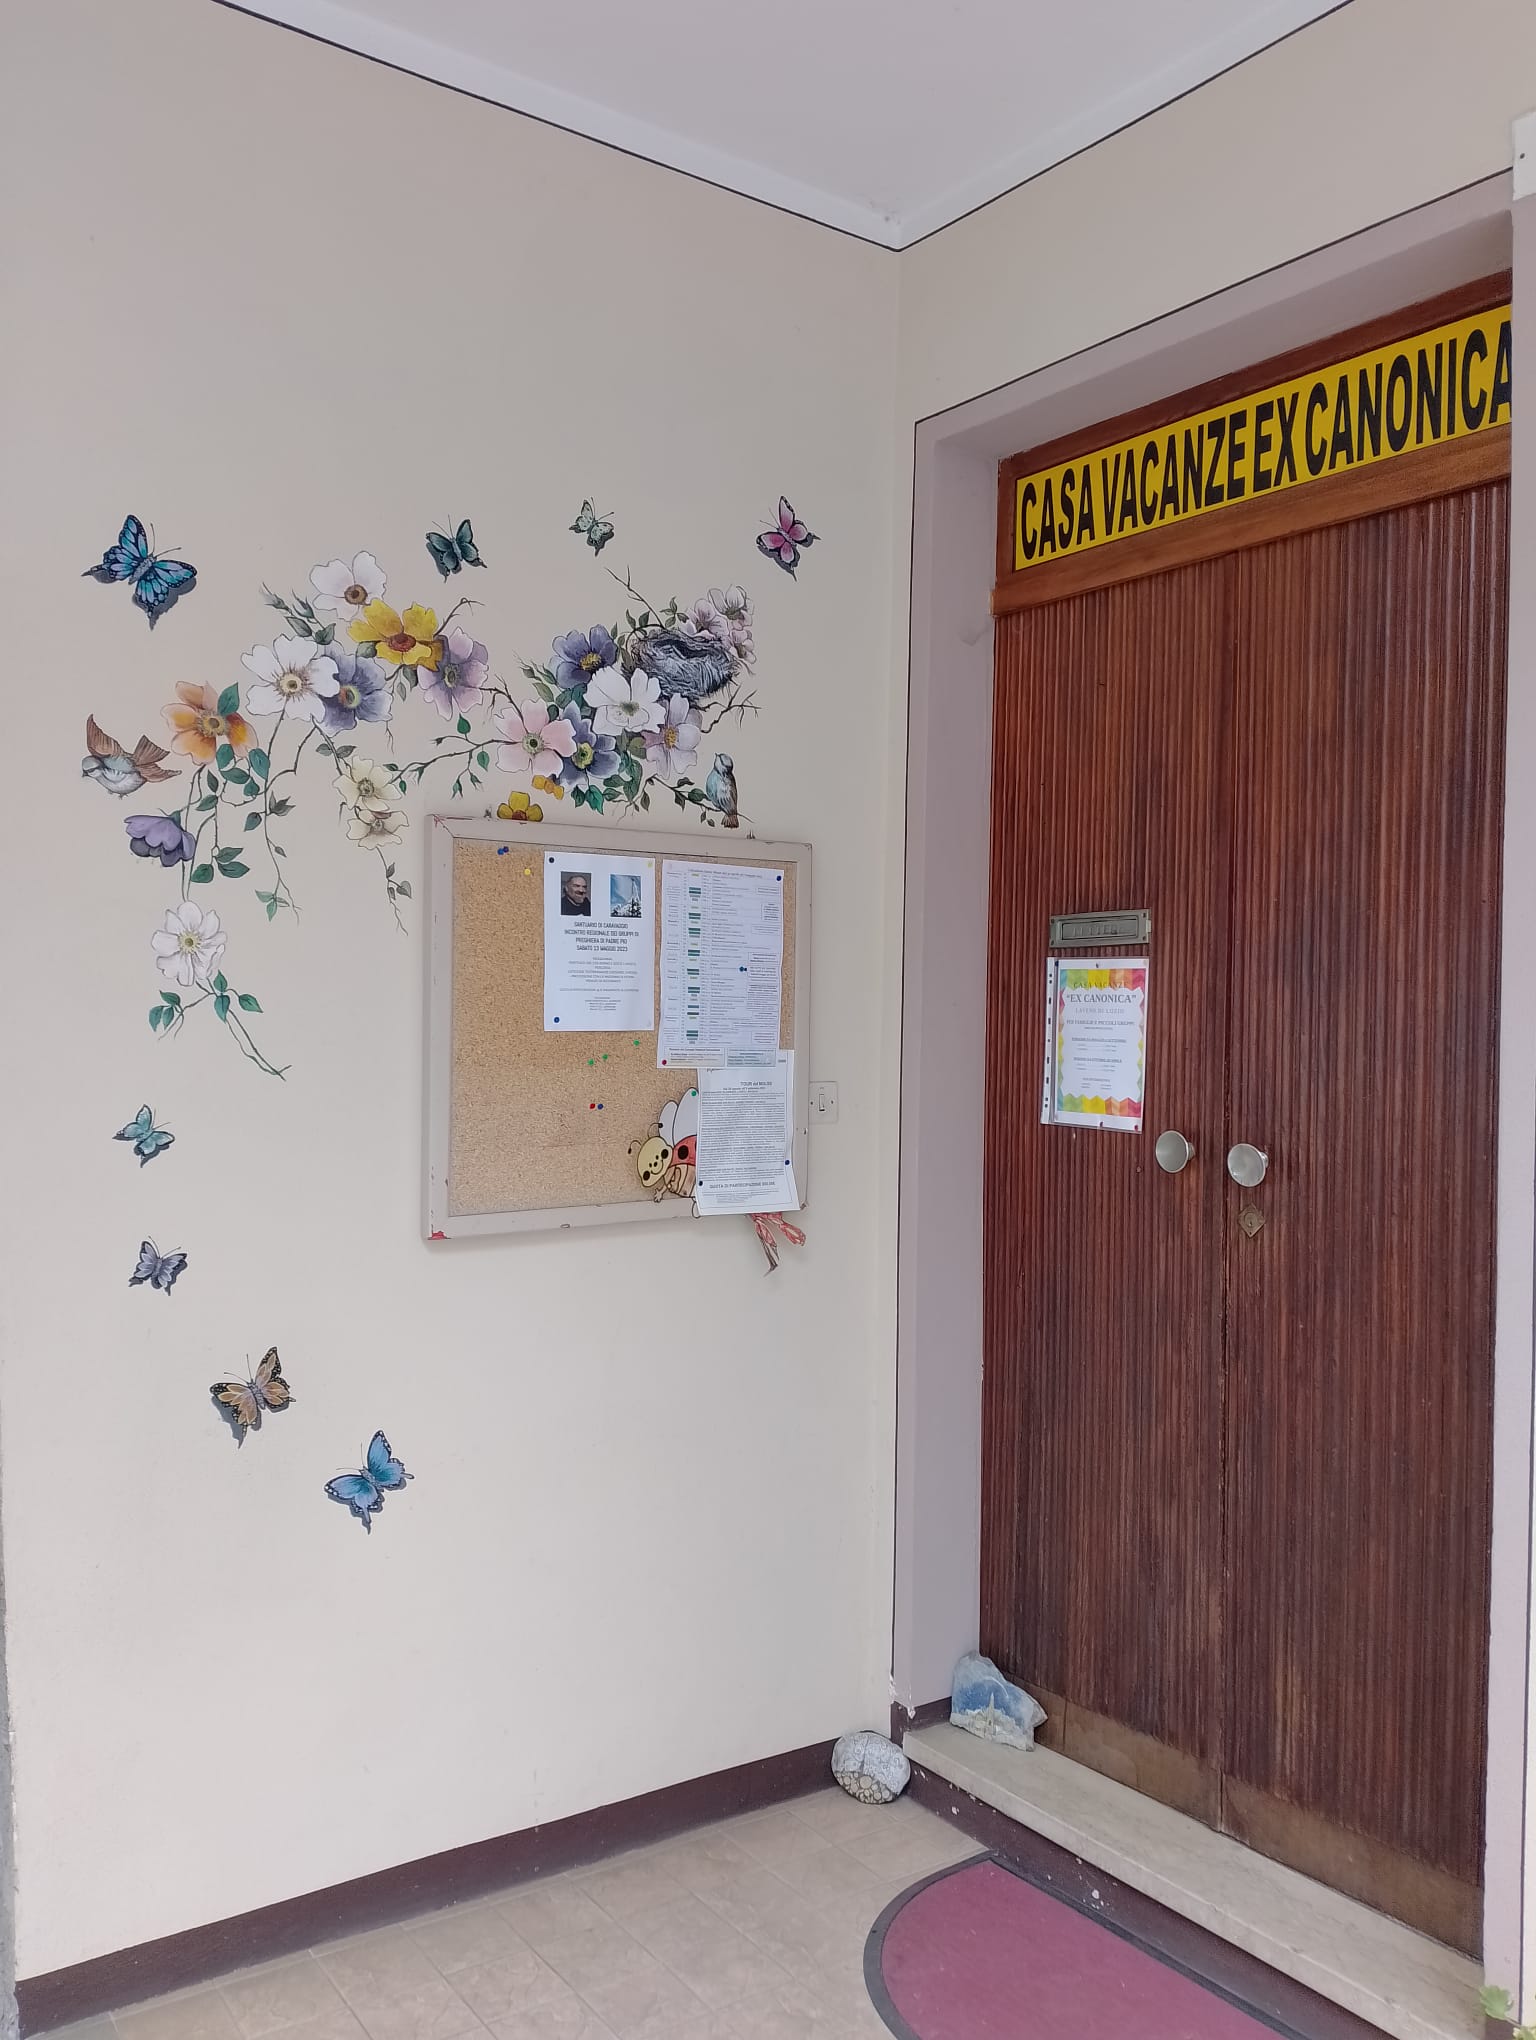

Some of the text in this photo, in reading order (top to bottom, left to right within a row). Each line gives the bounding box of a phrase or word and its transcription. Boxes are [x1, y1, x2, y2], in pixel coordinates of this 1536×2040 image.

[1021, 320, 1512, 561] CASA VACANZE EX CANONICA
